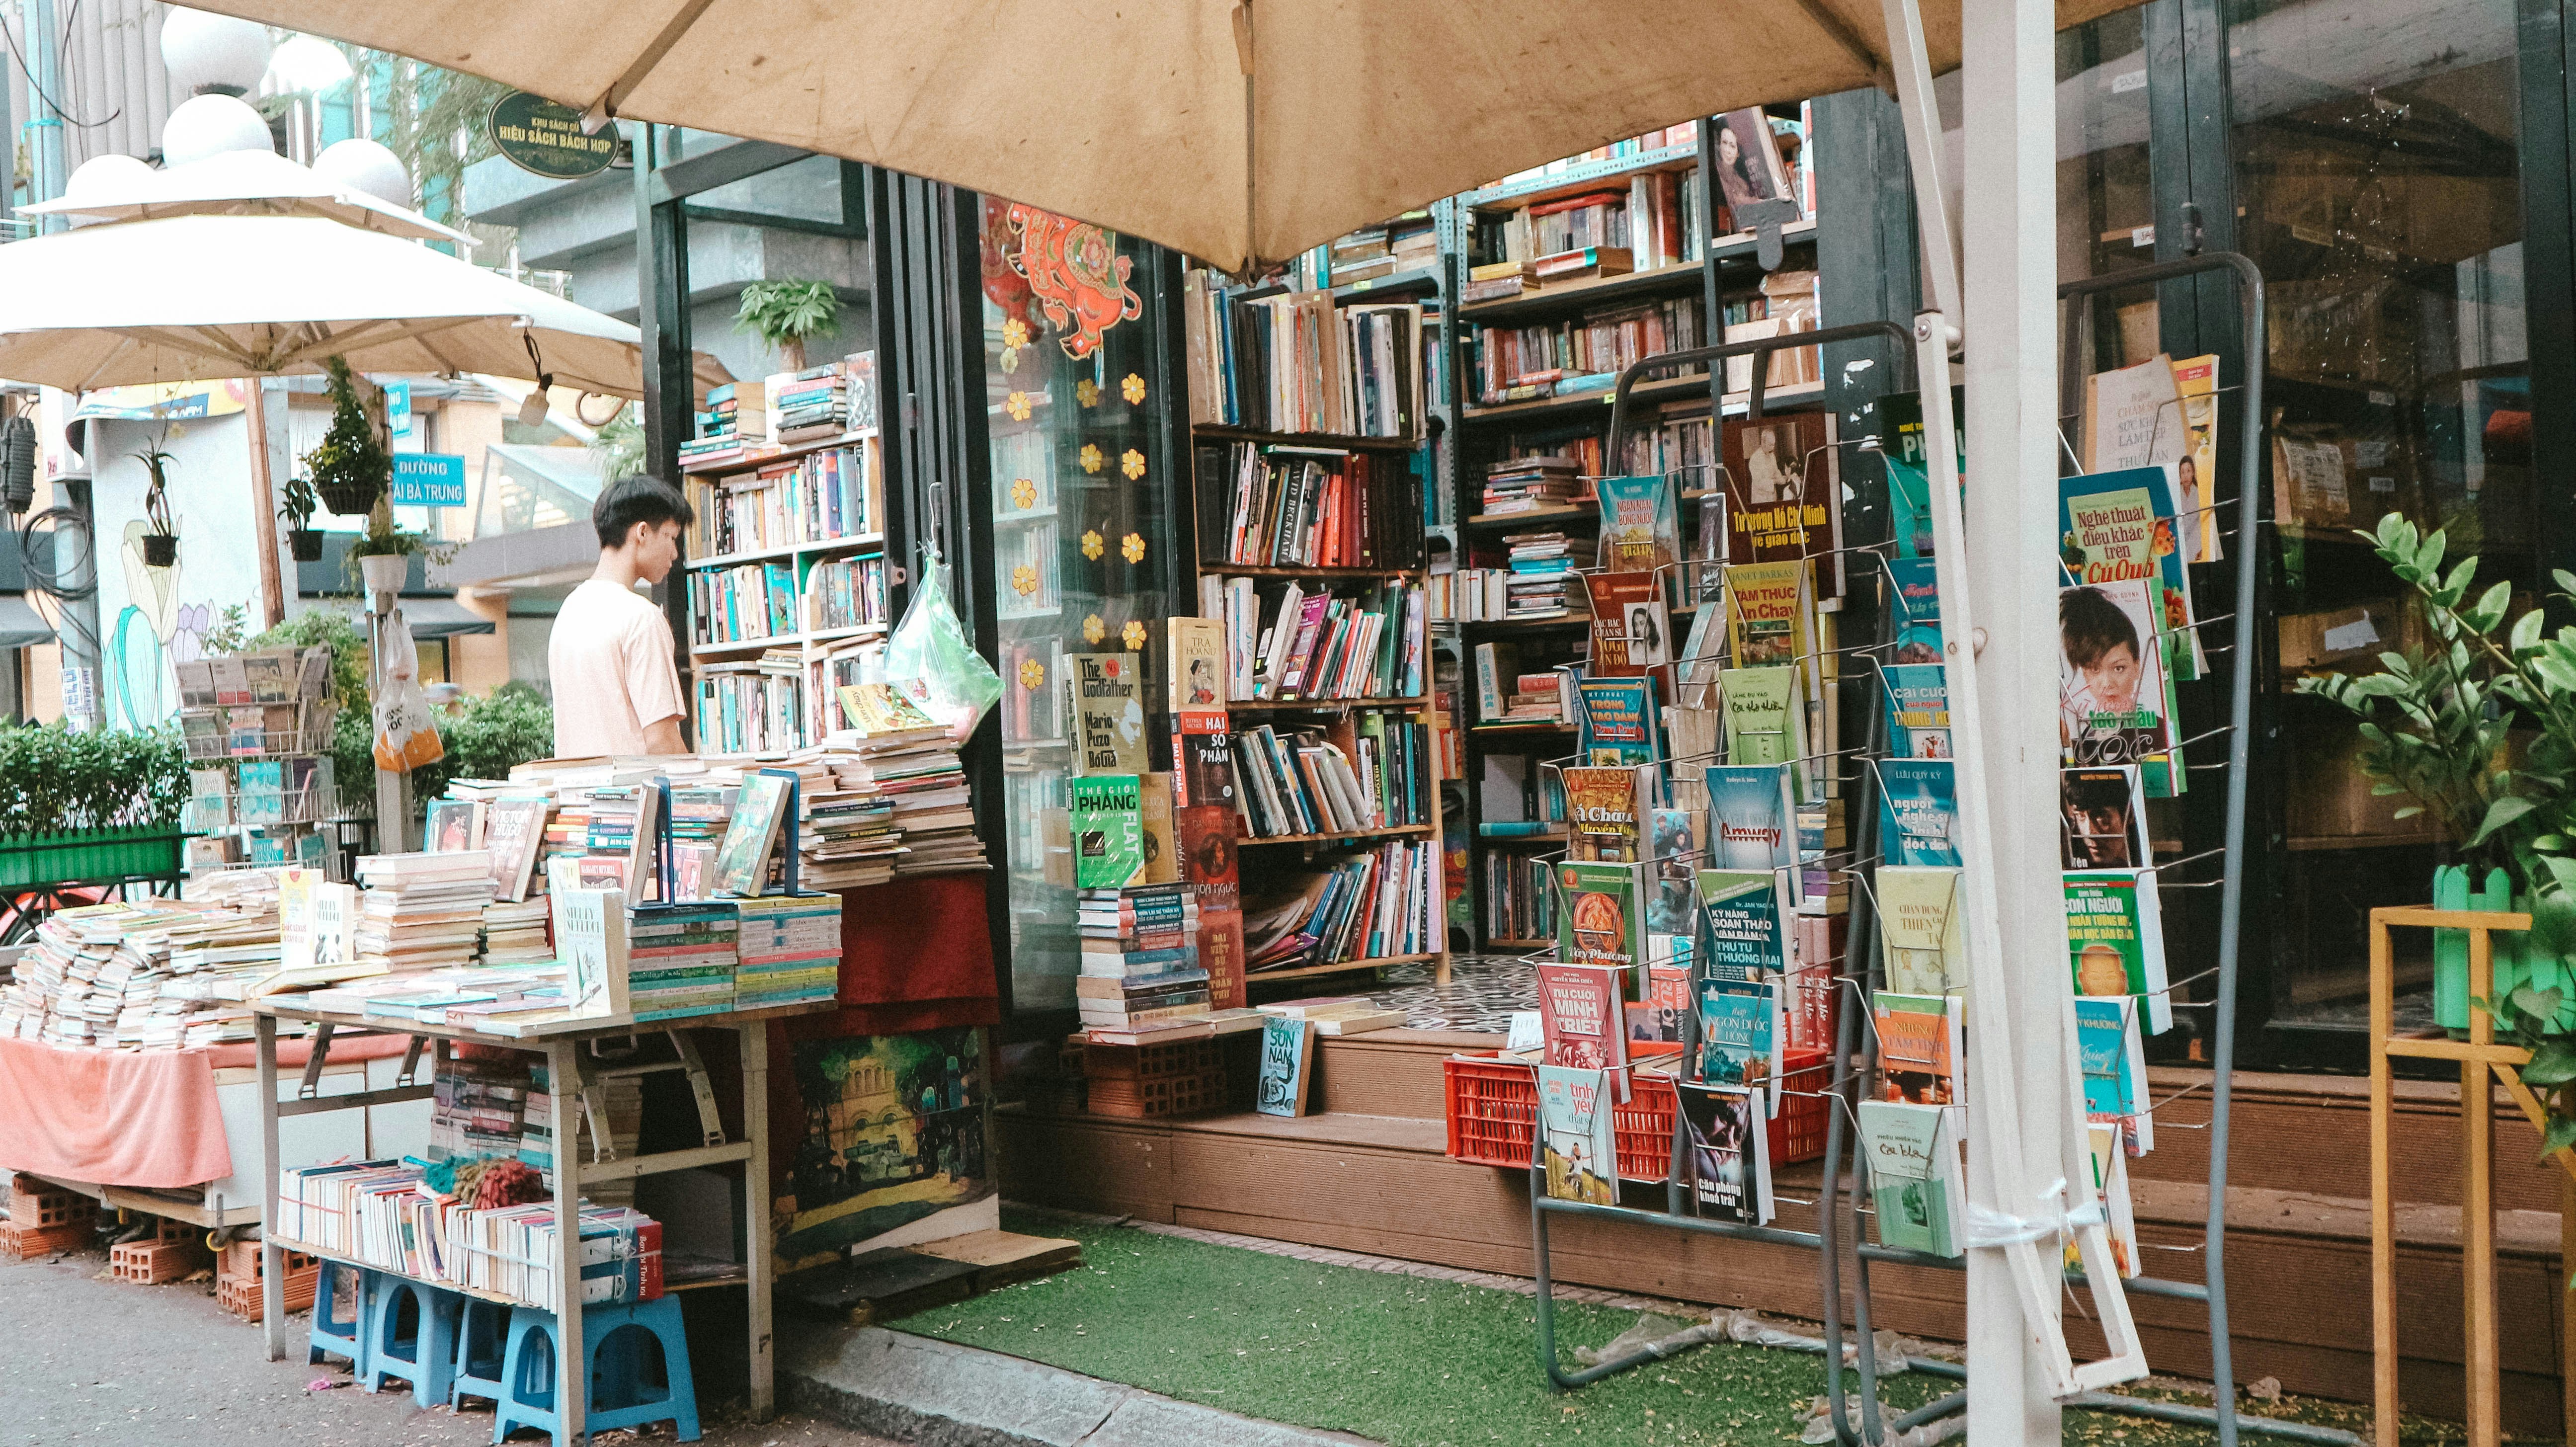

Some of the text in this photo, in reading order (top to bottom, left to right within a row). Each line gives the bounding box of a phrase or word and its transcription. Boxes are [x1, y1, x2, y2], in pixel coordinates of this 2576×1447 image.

[532, 117, 547, 128] KHU
[549, 118, 568, 132] SÁCH
[499, 125, 611, 154] HIỆU SÁCH BÁCH HỢP
[394, 478, 463, 501] AI BÀ TRƯNG
[1281, 461, 1301, 556] DAVID BECKHAM
[1774, 505, 1786, 528] Hồ
[1803, 503, 1826, 526] Minh
[1596, 638, 1625, 652] YOGI
[1080, 658, 1100, 677] The
[1082, 678, 1133, 697] Godfather
[1085, 711, 1113, 729] Mario
[1206, 717, 1225, 730] HAI
[1087, 729, 1110, 746] Puzo
[1211, 731, 1225, 747] SỐ
[1173, 758, 1181, 769] SỐ
[1200, 747, 1228, 764] PHẬN
[1078, 785, 1136, 795] THẾ GIỚI
[497, 807, 530, 823] VICTOR
[1589, 806, 1633, 822] Châu
[493, 823, 522, 837] HUGO
[1122, 811, 1139, 855] FLAT
[1721, 823, 1781, 848] Amway
[1922, 905, 1942, 914] DUNG
[2087, 895, 2124, 913] NGƯỜI
[1713, 917, 1772, 930] SOẠN THẢO
[1717, 941, 1737, 952] THƯ
[1718, 952, 1760, 964] THƯƠNG
[1554, 999, 1598, 1018] MINH
[1269, 1048, 1292, 1064] NAM
[1698, 1178, 1741, 1197] Căn phòng
